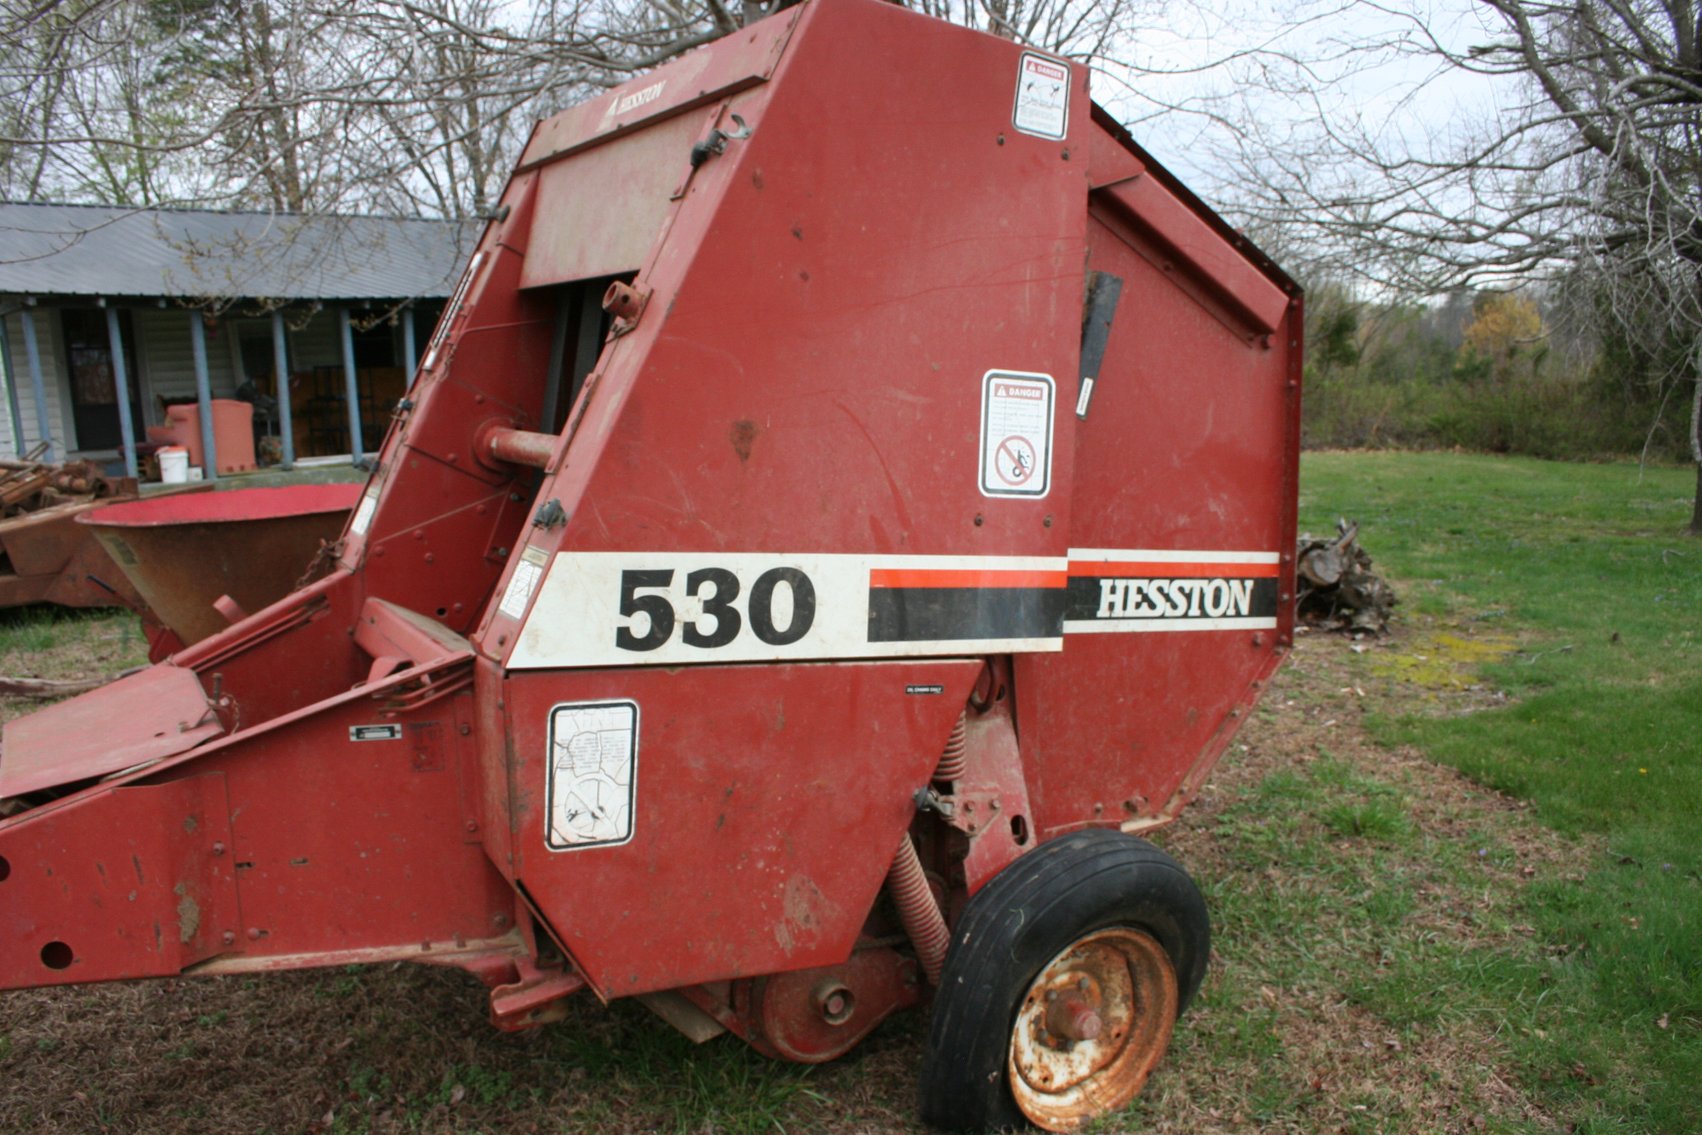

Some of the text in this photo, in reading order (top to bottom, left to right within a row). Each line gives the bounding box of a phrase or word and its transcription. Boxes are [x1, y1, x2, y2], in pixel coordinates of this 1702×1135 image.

[1008, 387, 1041, 396] DANGER
[616, 567, 816, 652] 530
[1096, 578, 1255, 618] HESSTON
